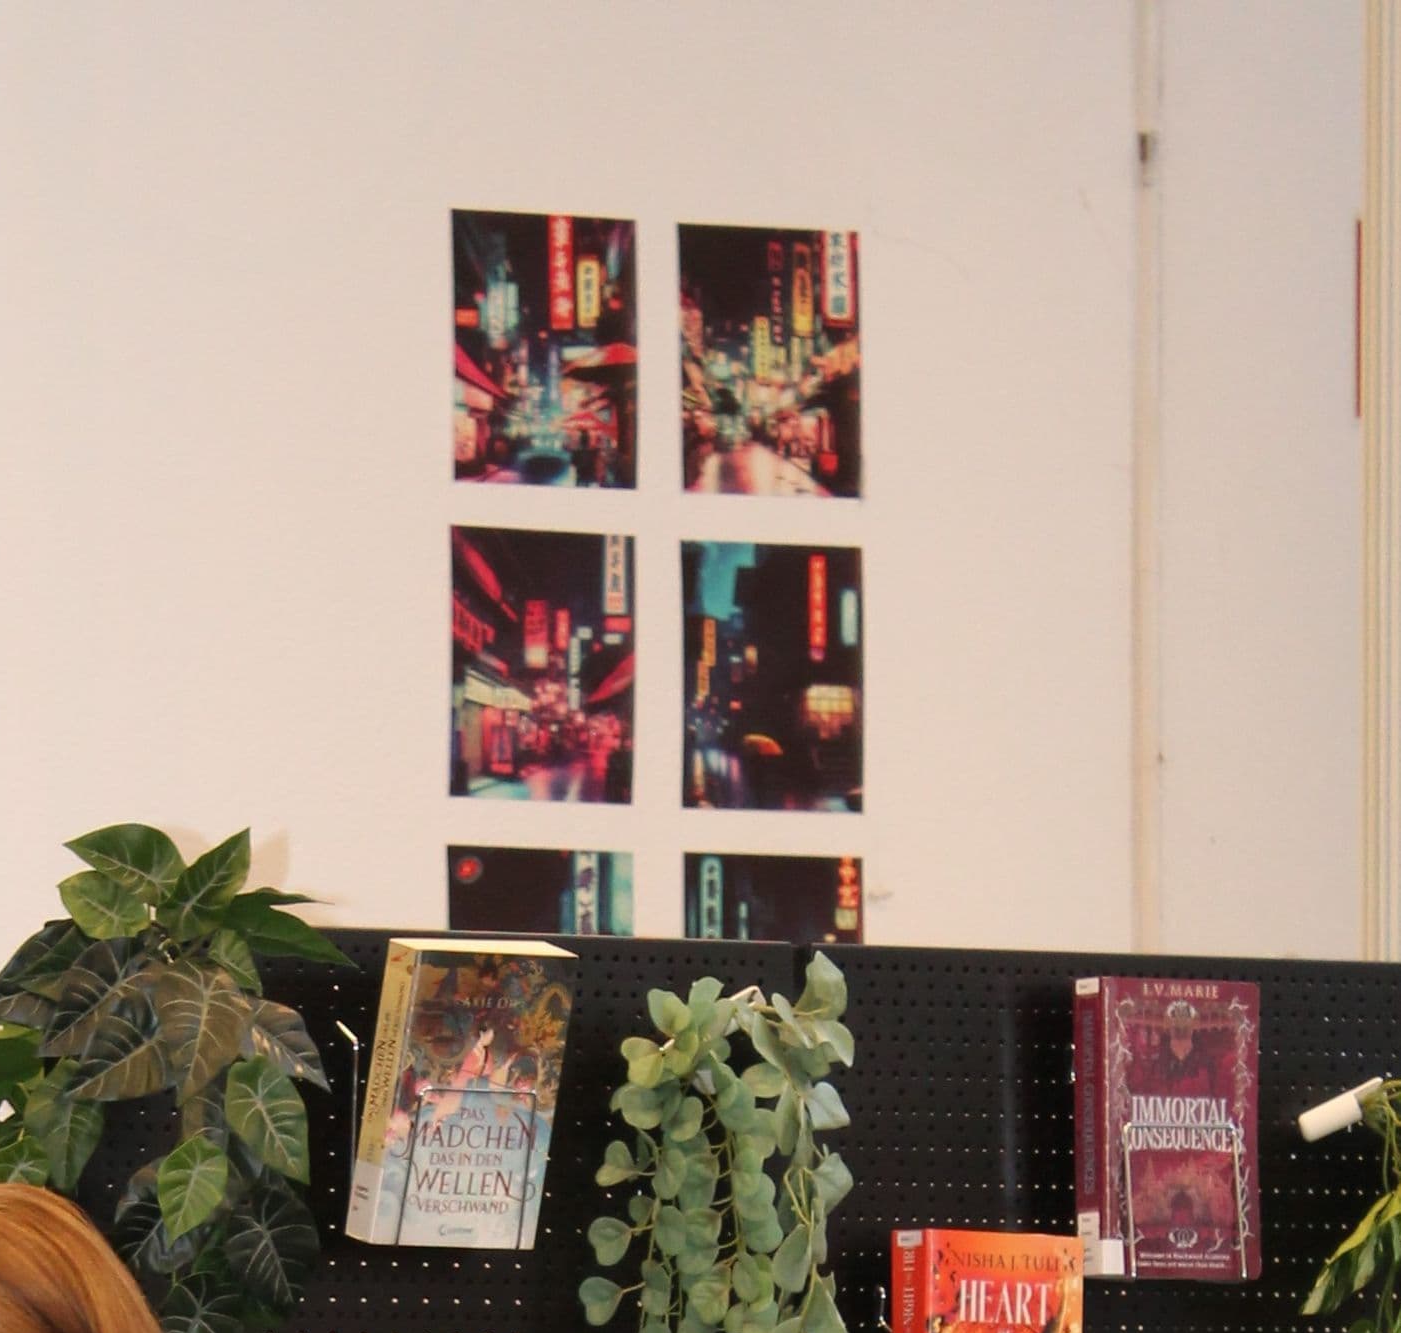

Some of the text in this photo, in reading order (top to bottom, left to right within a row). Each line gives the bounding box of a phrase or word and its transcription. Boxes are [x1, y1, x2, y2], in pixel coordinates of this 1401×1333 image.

[460, 1107, 486, 1121] DAS
[1132, 1095, 1234, 1126] IMMORTAL
[429, 1152, 503, 1166] DAS IN DEN
[411, 1162, 535, 1202] WELLEN
[407, 1194, 509, 1215] VERSCHWAND
[951, 1249, 1005, 1269] NISHA
[959, 1279, 1054, 1327] HEART
